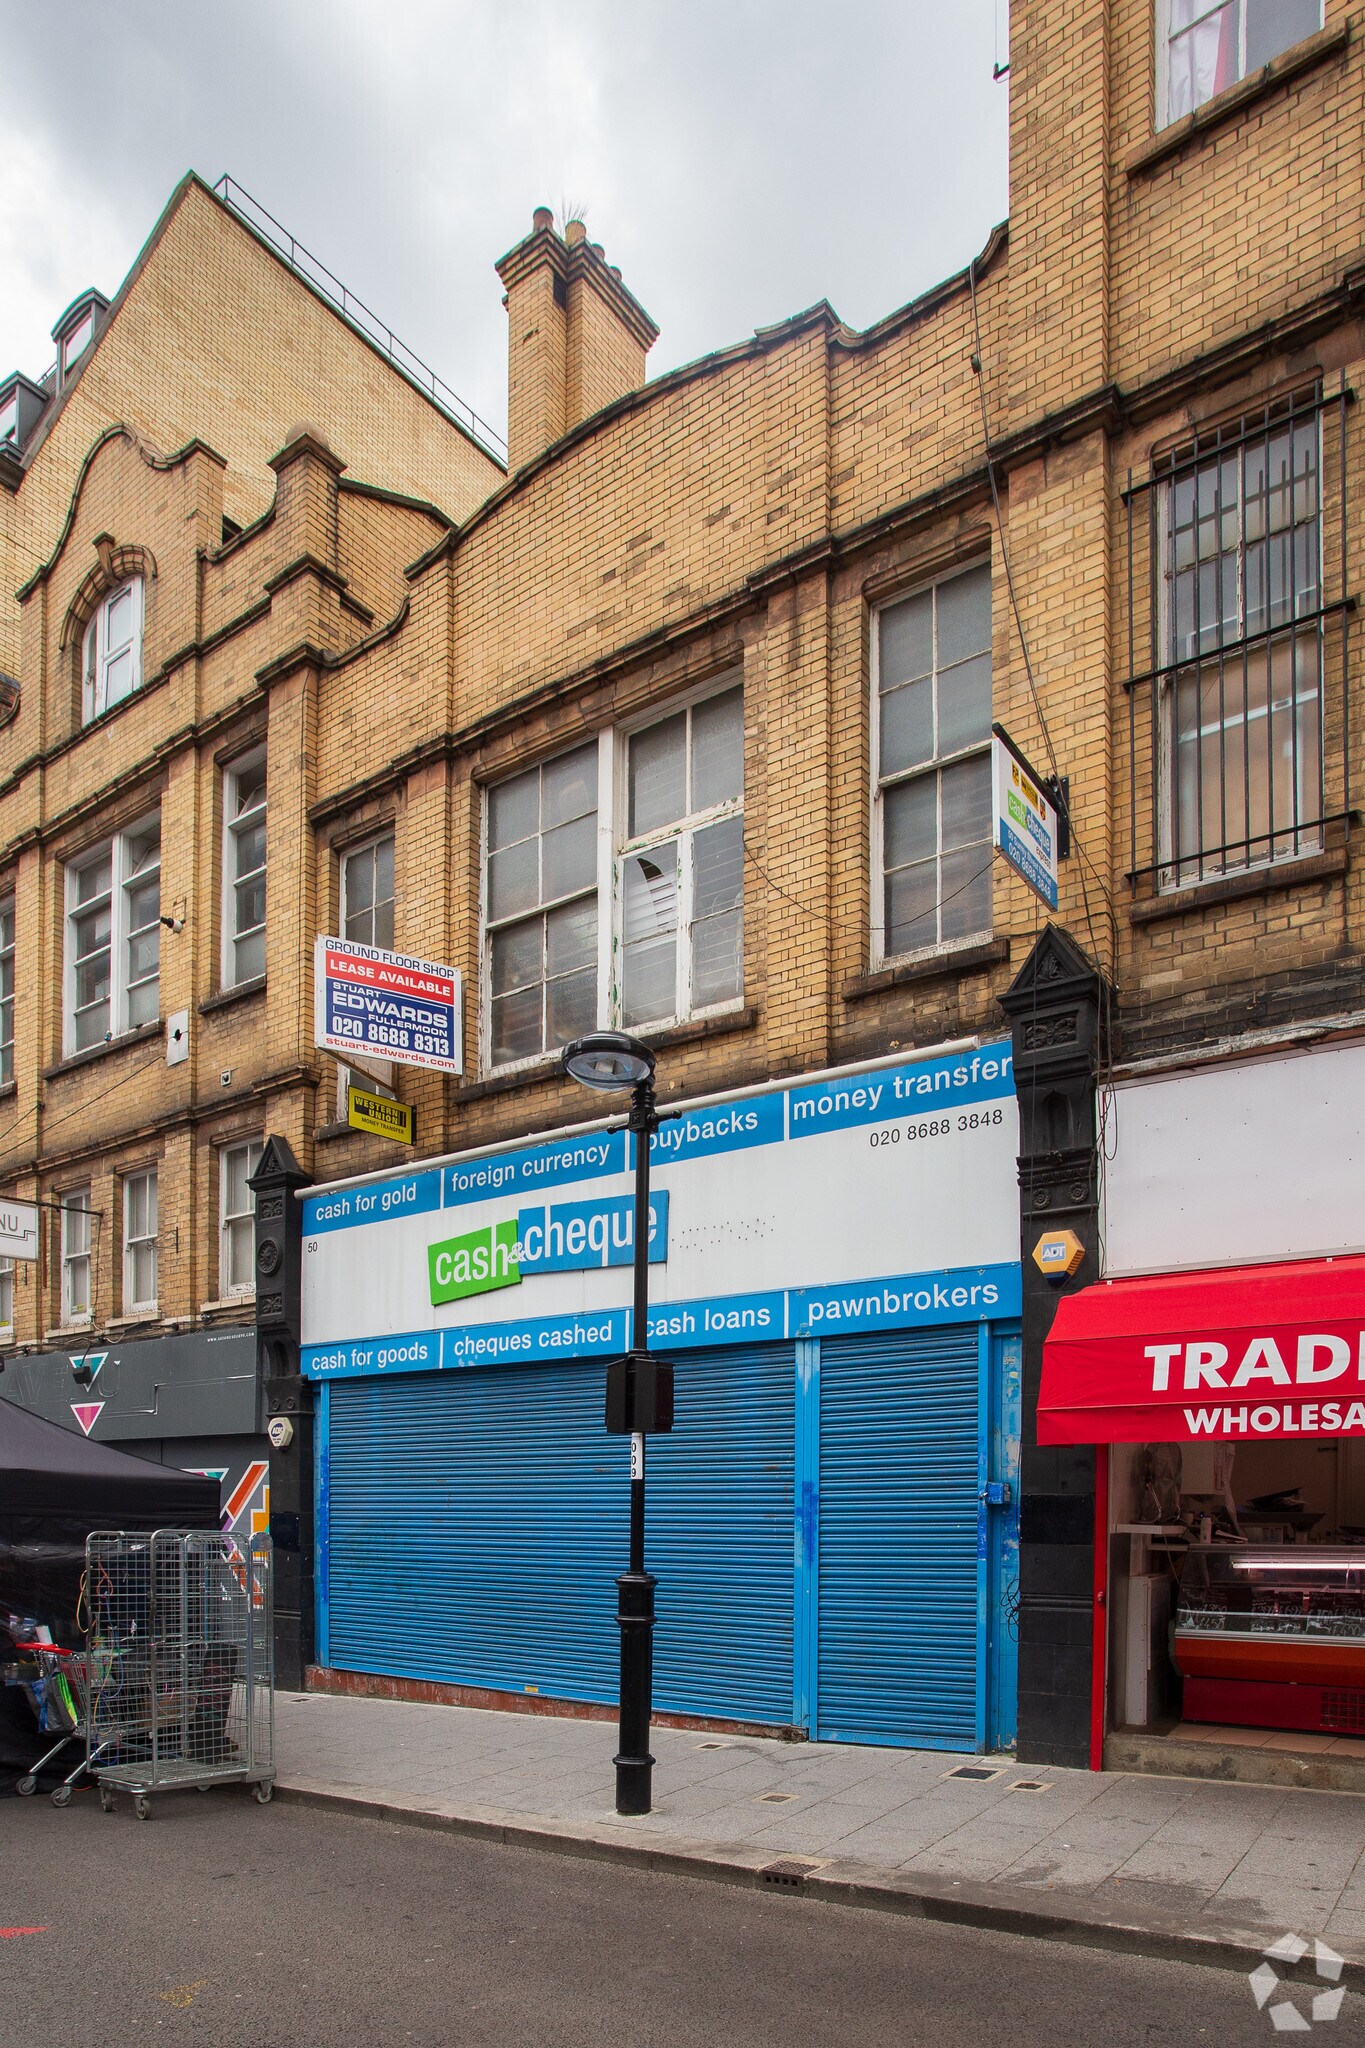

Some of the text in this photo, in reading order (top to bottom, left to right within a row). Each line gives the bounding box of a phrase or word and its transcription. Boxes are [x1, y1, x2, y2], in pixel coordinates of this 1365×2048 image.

[326, 940, 454, 979] GROUND FLOOR SHOP
[330, 958, 450, 997] LEASE AVAILABLE
[333, 981, 381, 998] STUART
[333, 990, 448, 1028] EDWARDS
[368, 1014, 447, 1037] FULLERMOON
[326, 1036, 455, 1069] stuart-edwards.com
[332, 1015, 449, 1056] 020 8688 8313
[793, 1056, 1012, 1121] money transfer
[354, 1096, 398, 1117] WESTERN
[368, 1109, 399, 1126] UNION
[361, 1116, 405, 1135] MONEY TRANSFER
[869, 1109, 1003, 1148] 020 8688 3848
[452, 1143, 610, 1192] foreign currency
[315, 1183, 417, 1222] cash for gold
[307, 1242, 318, 1253] 50
[1042, 1243, 1066, 1261] ADT
[647, 1306, 771, 1338] cash loans
[807, 1283, 999, 1326] pawnbrokers
[312, 1342, 428, 1371] cash for goods
[454, 1320, 612, 1359] cheques cashed
[1144, 1330, 1365, 1391] TRAD
[1184, 1402, 1365, 1434] WHOLESA
